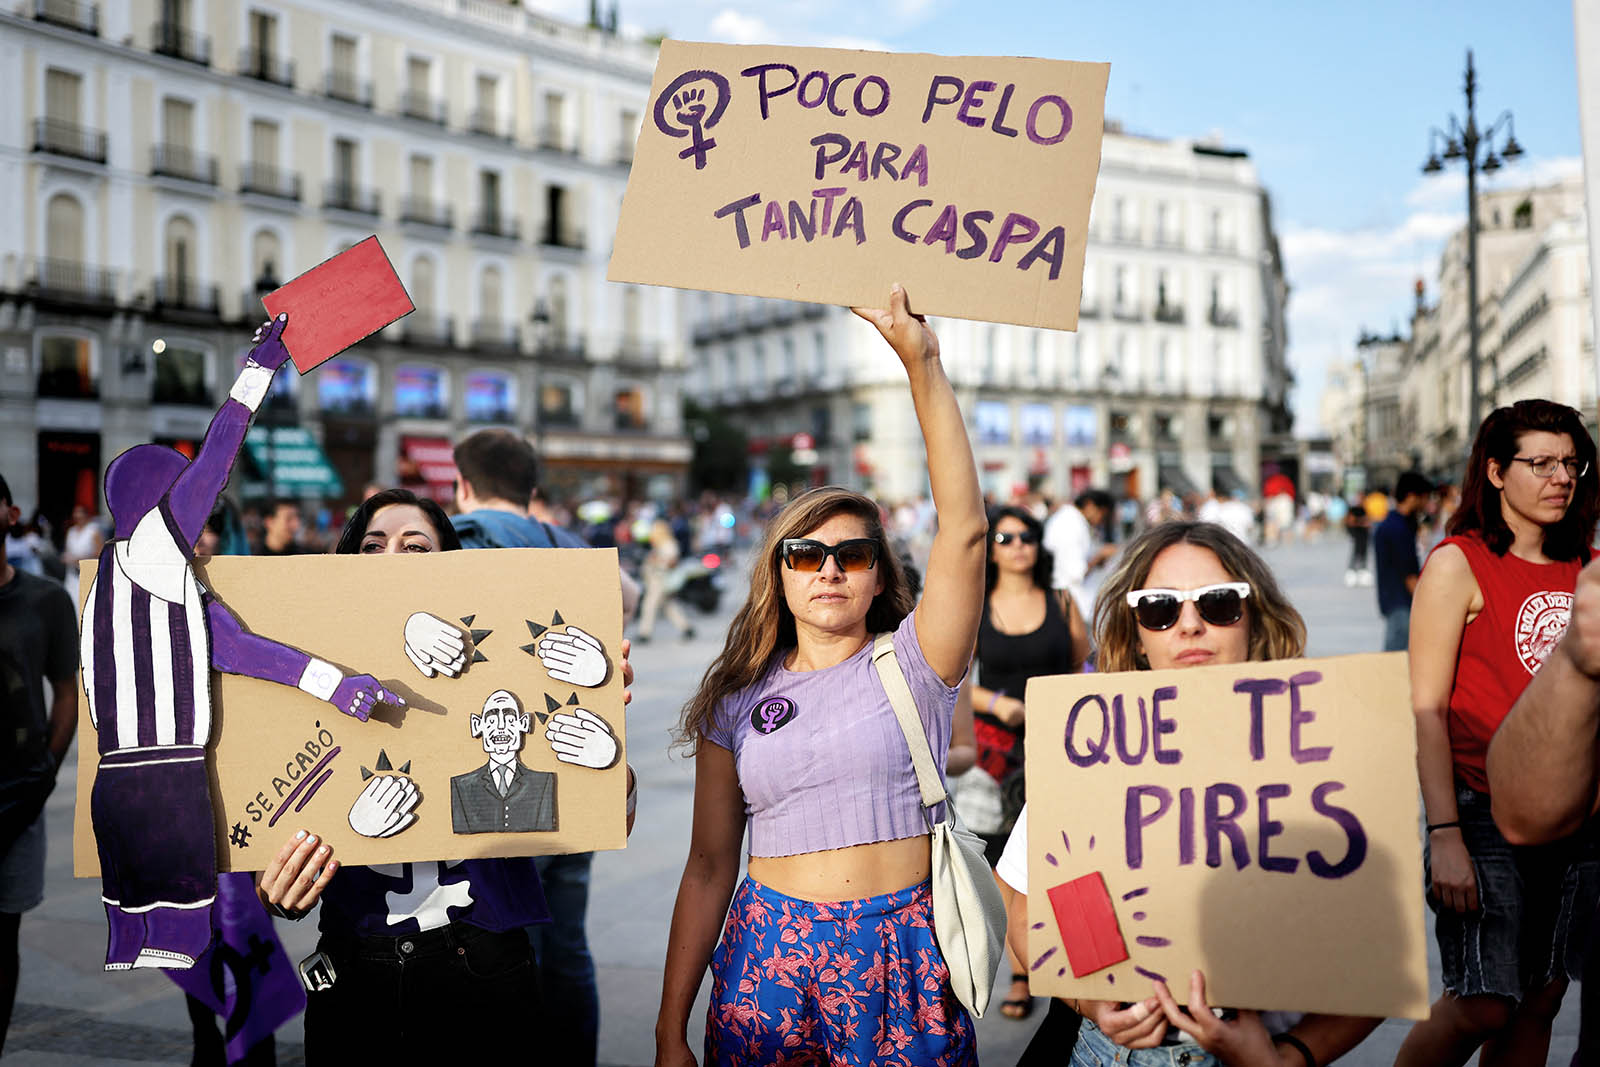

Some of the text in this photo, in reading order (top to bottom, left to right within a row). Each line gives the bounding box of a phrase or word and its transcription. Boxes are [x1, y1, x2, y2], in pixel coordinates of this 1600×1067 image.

[741, 63, 1074, 145] POCO PELO
[810, 133, 929, 187] PARA
[713, 187, 1066, 281] TANTA CASPA
[1064, 671, 1334, 768] QUE TE
[1124, 781, 1368, 879] PIRES
